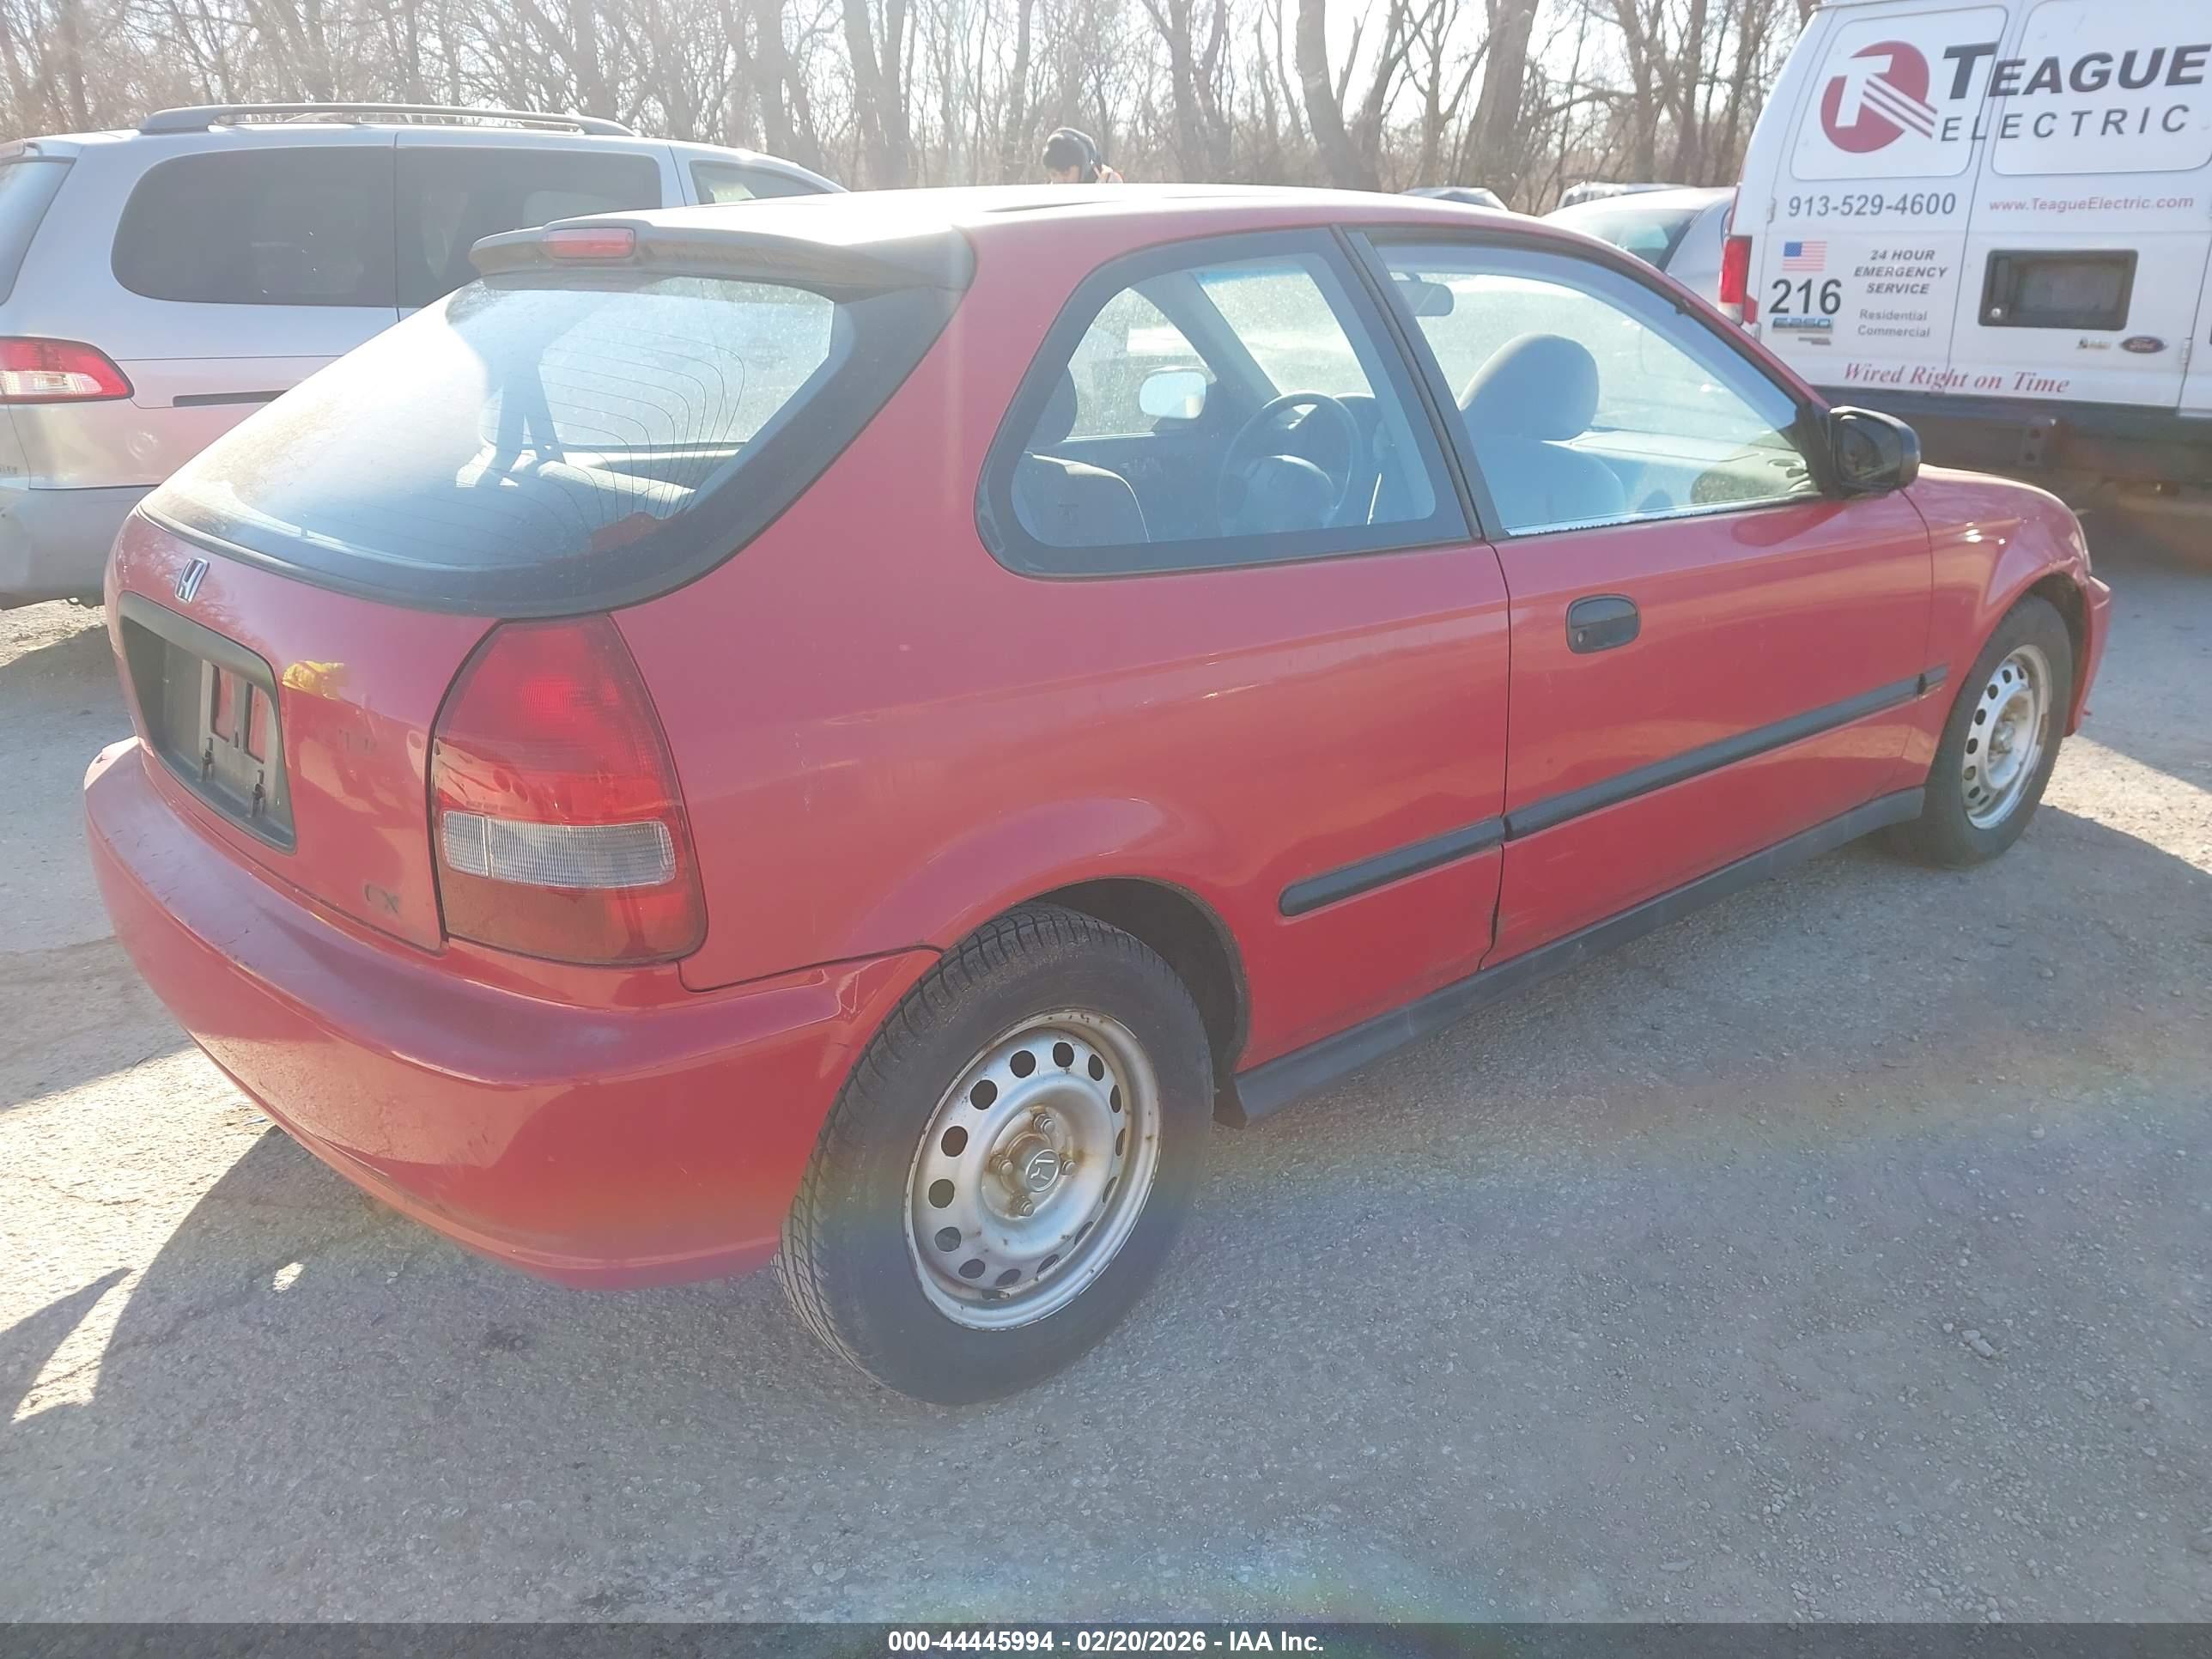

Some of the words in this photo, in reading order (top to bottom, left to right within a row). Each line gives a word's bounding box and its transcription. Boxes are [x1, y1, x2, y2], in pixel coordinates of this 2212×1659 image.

[1942, 41, 2212, 100] TEAGUE
[1941, 104, 2190, 142] ELECTRIC
[1788, 192, 1956, 217] 913-529-4600
[1989, 196, 2194, 213] www.TeagueElectric.com
[1869, 249, 1887, 260] 24
[1892, 249, 1936, 260] HOUR
[1853, 266, 1948, 278] EMERGENCY
[1768, 277, 1842, 315] 216
[1866, 283, 1930, 295] SERVICE
[1859, 309, 1928, 321] Residential
[1857, 325, 1930, 337] Commercial
[1844, 362, 1905, 384] Wired
[1909, 366, 1969, 391] Right
[1973, 373, 2002, 389] on
[2014, 372, 2070, 393] Time
